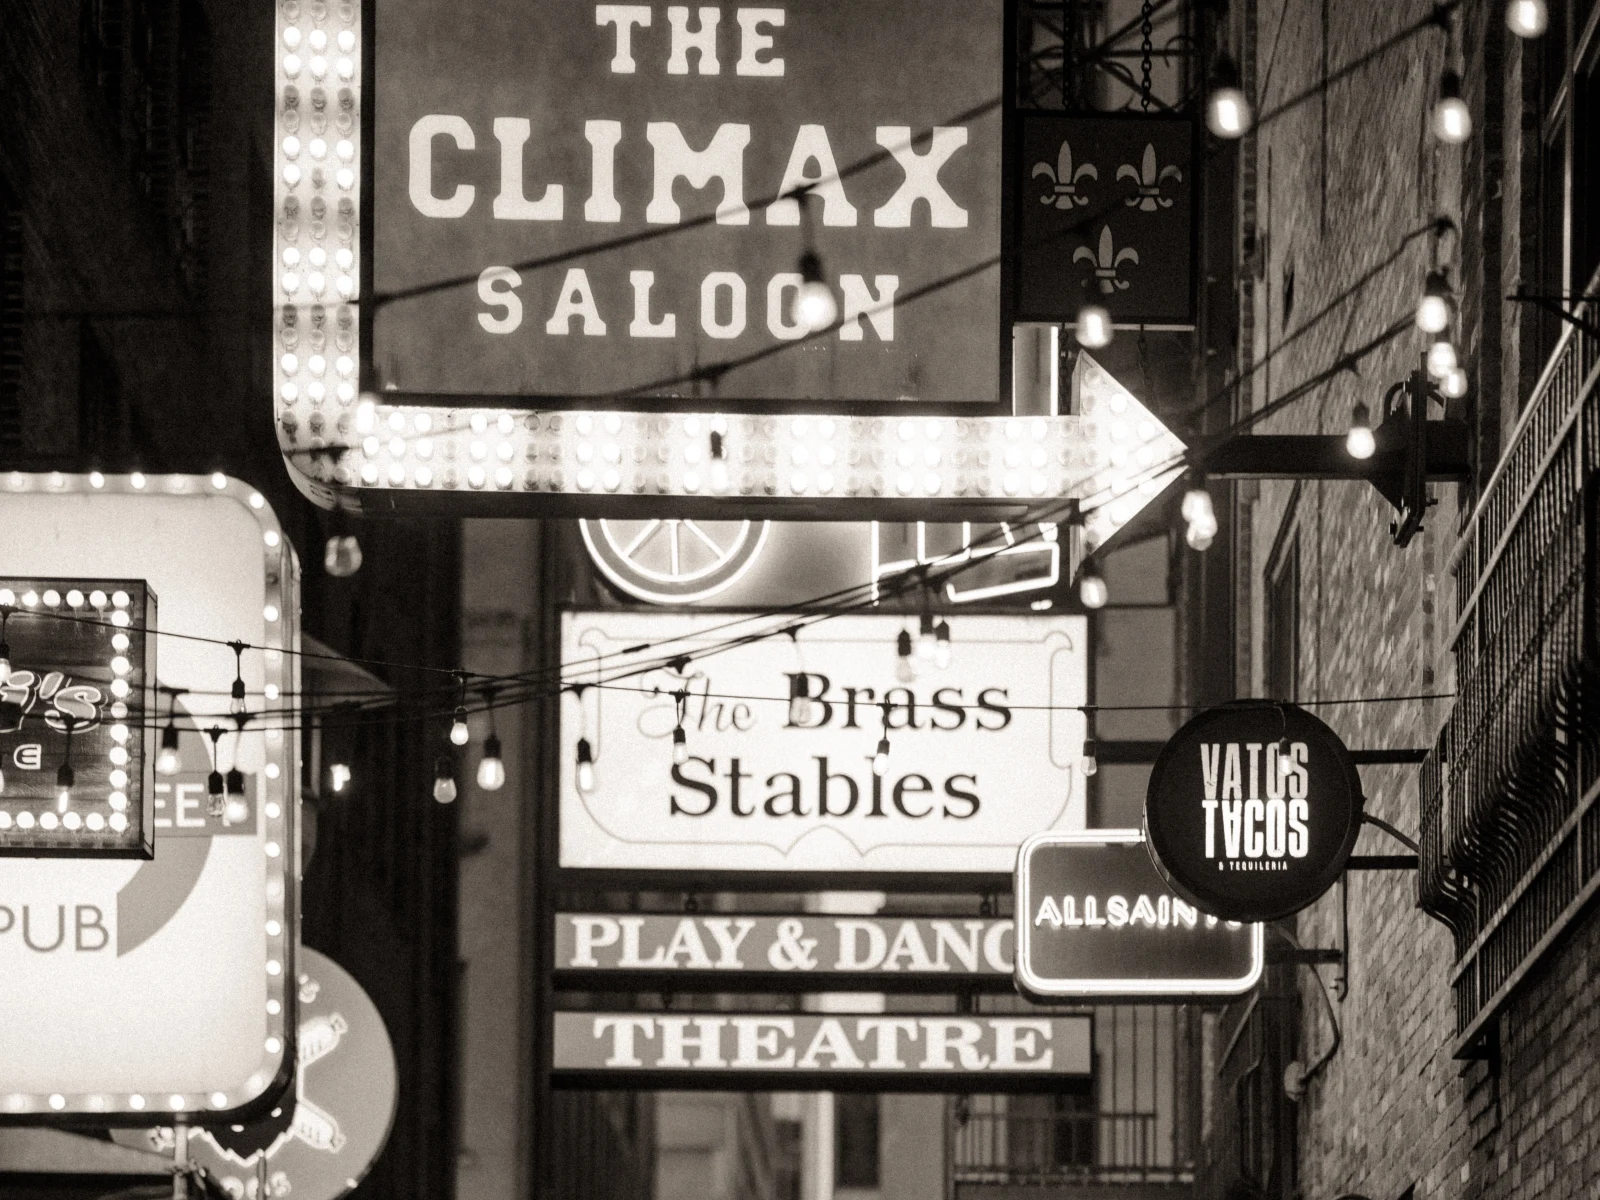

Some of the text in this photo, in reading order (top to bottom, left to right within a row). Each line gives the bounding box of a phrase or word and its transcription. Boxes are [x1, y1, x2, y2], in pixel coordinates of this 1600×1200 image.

[595, 5, 786, 77] THE
[407, 114, 969, 228] CLIMAX
[477, 265, 900, 342] SALOON
[637, 668, 1012, 738] The Brass
[669, 755, 981, 820] Stables
[1200, 741, 1309, 799] VATOS
[1201, 799, 1309, 858] TACOS
[1230, 861, 1288, 871] TEQUILERIA
[0, 904, 109, 953] PUB
[1034, 894, 1241, 927] ALLSAIN
[570, 917, 756, 970] PLAY
[767, 917, 818, 971] &
[593, 1017, 1053, 1071] THEATRE
